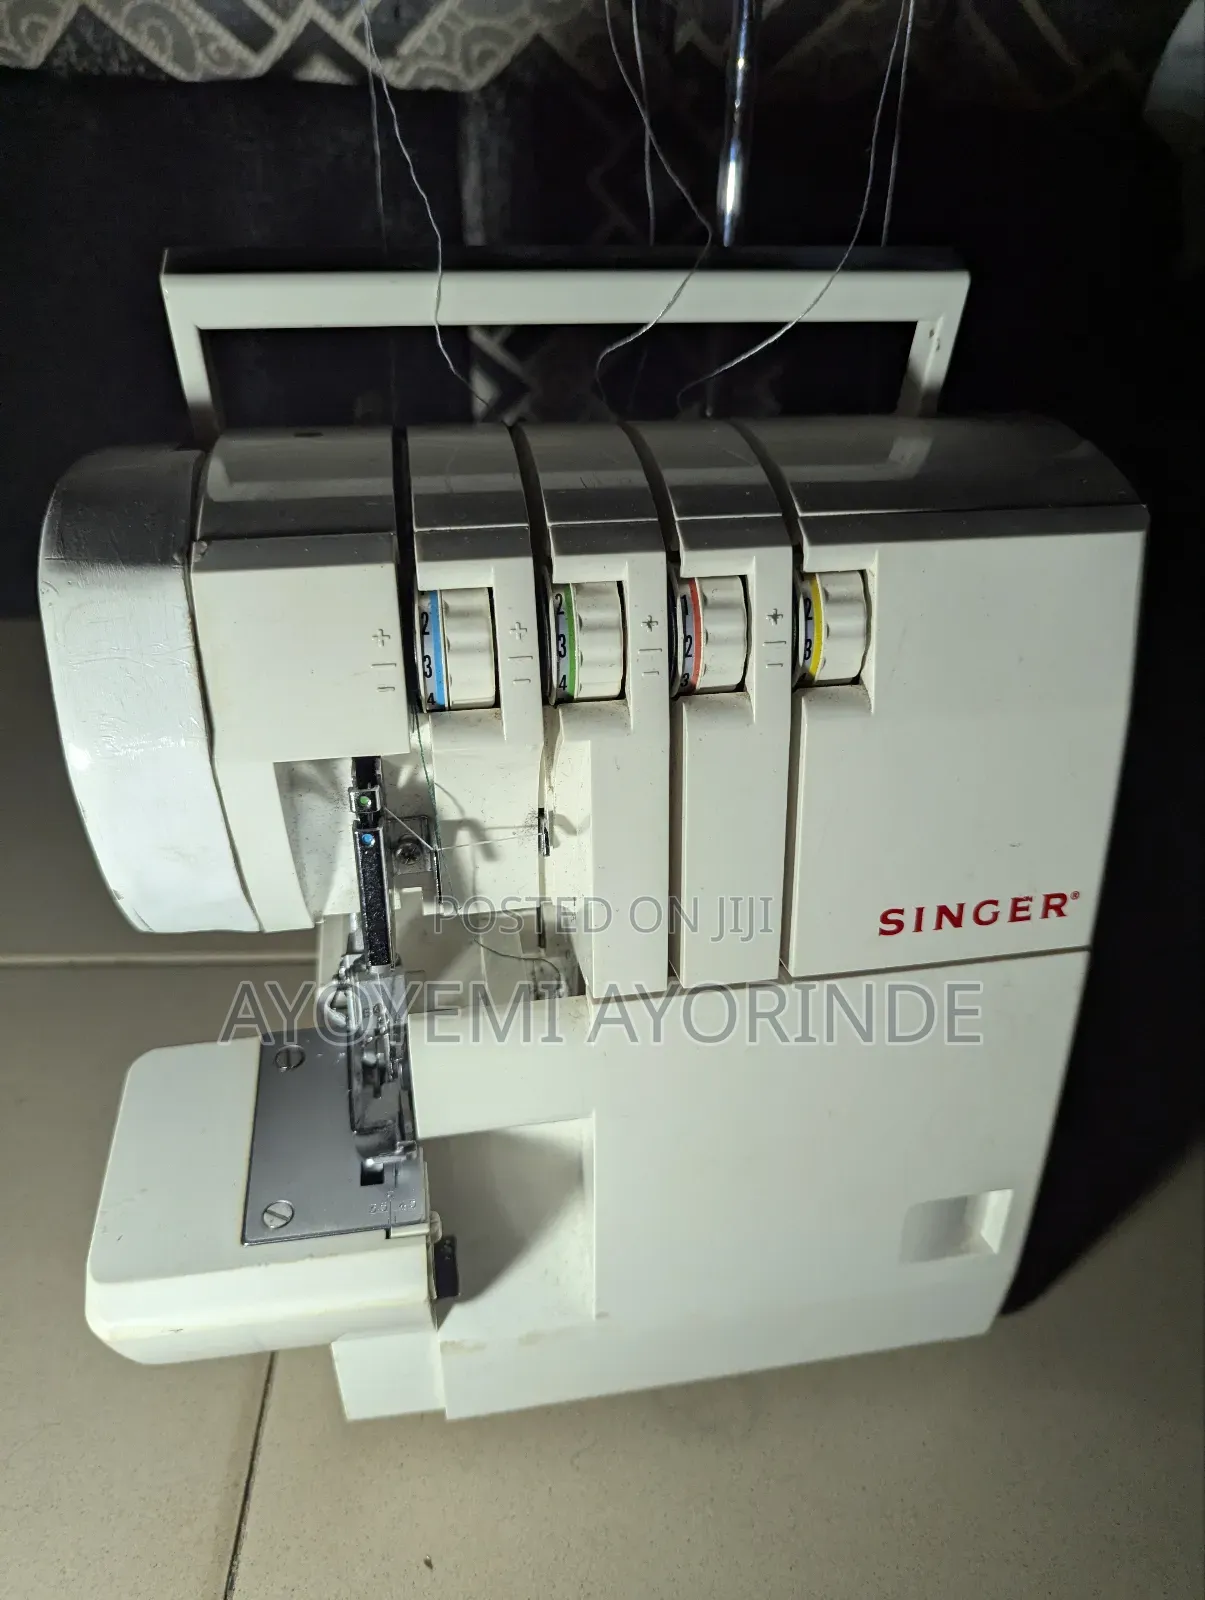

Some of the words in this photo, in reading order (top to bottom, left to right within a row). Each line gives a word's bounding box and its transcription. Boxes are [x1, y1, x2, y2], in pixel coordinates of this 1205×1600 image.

[555, 593, 565, 615] 2
[804, 597, 813, 621] 2
[421, 611, 430, 636] 2
[558, 633, 567, 658] 3
[684, 634, 693, 658] 2
[803, 638, 813, 661] 3
[423, 654, 432, 678] 3
[559, 674, 567, 691] 4
[680, 672, 690, 688] 3
[427, 692, 435, 705] 4
